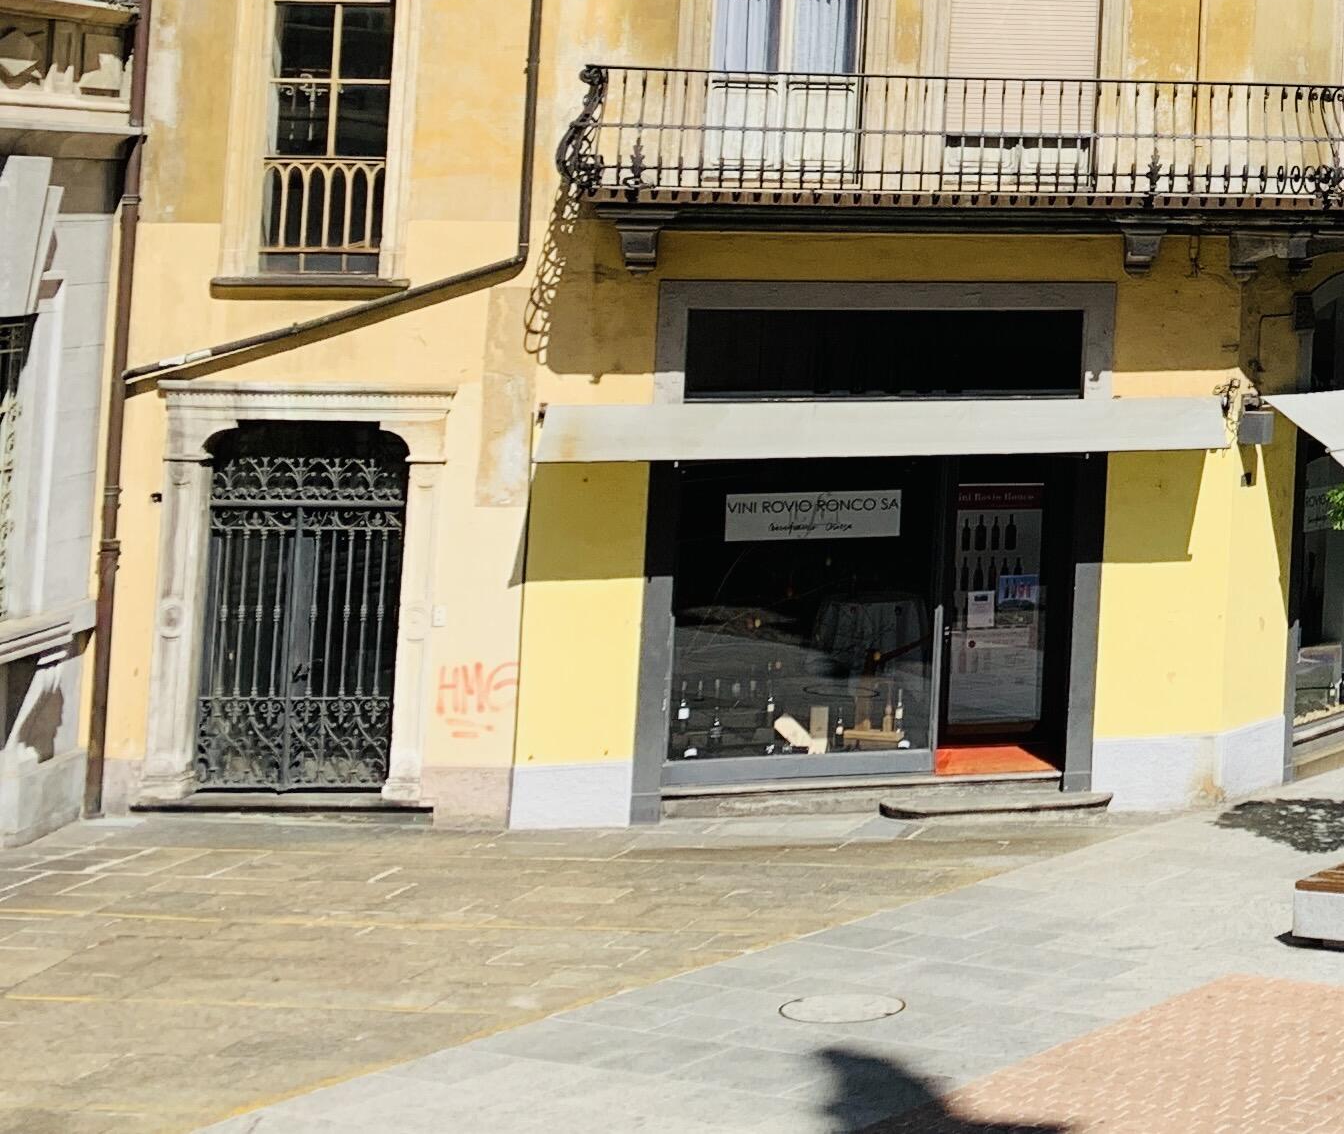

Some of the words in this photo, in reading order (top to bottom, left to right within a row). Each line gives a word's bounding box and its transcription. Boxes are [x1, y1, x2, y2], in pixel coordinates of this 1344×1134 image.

[727, 501, 757, 514] VINI
[762, 499, 812, 514] ROVIO
[815, 498, 877, 513] RONCO
[880, 498, 899, 511] SA
